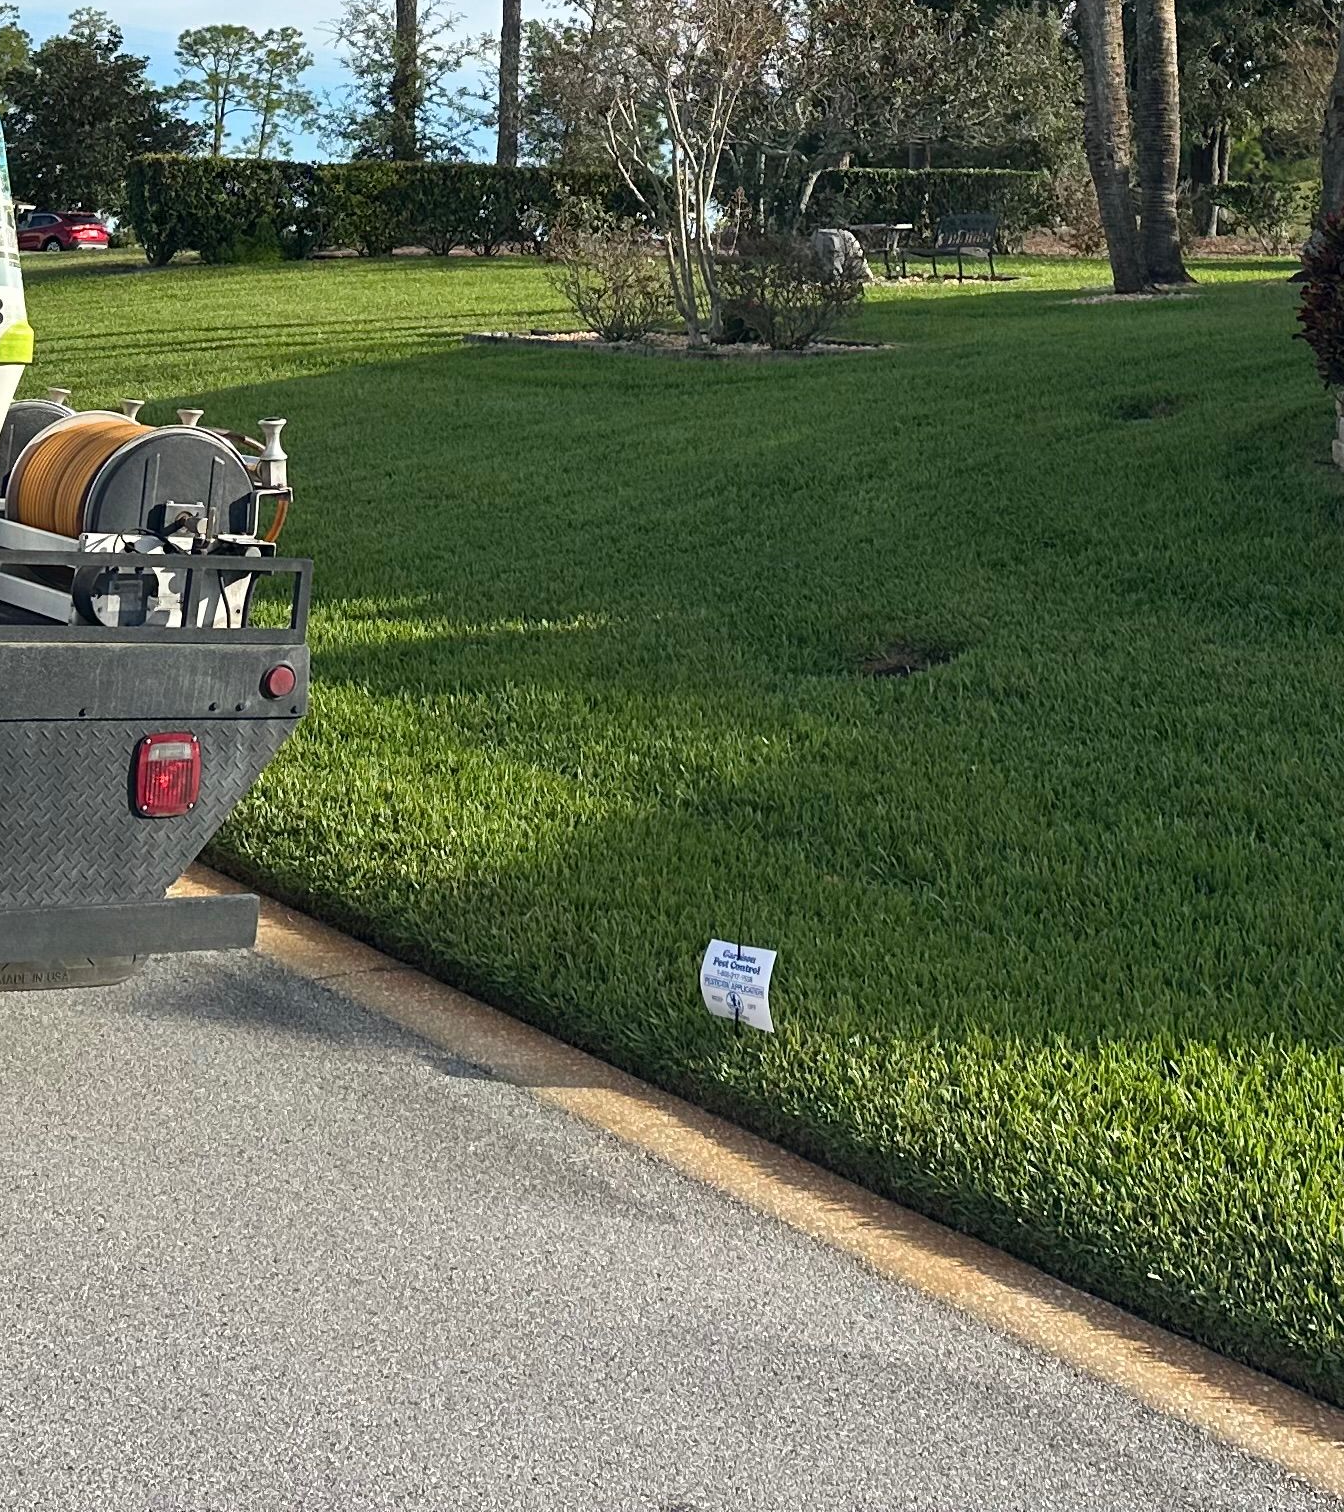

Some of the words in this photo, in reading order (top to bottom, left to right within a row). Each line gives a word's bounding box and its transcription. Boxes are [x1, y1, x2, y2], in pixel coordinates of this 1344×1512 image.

[722, 949, 756, 964] Garison
[712, 956, 729, 968] Pest
[730, 961, 761, 975] Control
[46, 970, 70, 983] USA
